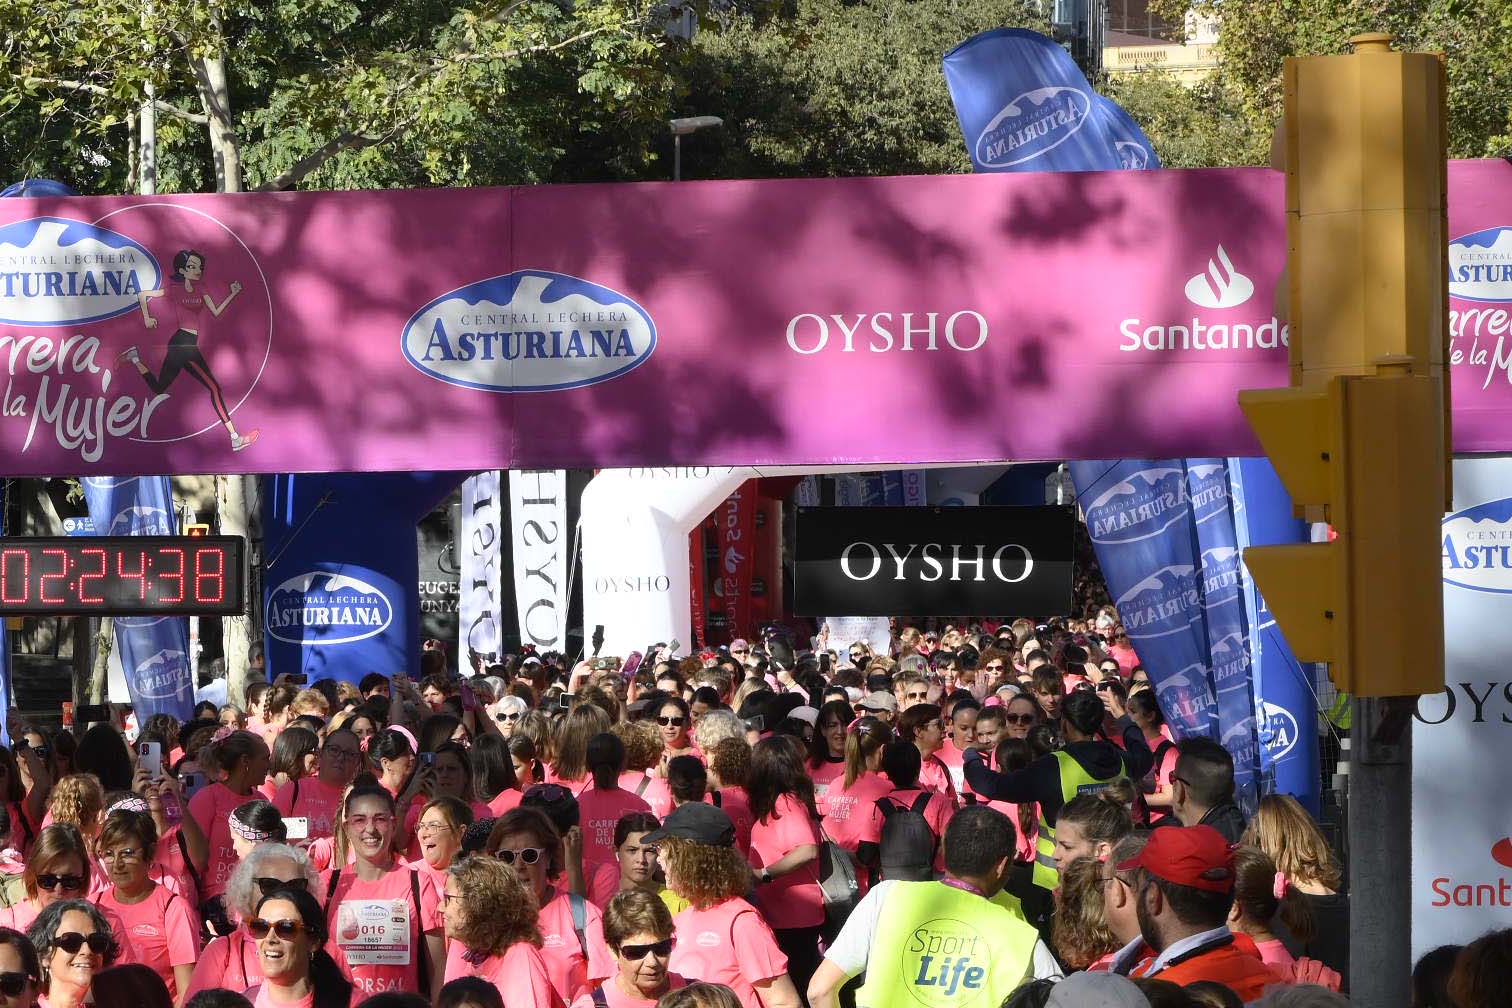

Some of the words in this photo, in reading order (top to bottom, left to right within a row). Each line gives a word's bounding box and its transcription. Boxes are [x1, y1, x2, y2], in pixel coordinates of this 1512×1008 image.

[64, 253, 136, 265] LECHERA
[461, 311, 539, 326] CENTRAL
[547, 310, 629, 323] LECHERA
[786, 309, 989, 354] OYSHO
[421, 316, 637, 362] ASTURIANA
[1469, 338, 1487, 366] la
[2, 375, 27, 418] la
[22, 368, 171, 463] Mujer
[521, 470, 559, 647] OYSH
[840, 541, 1034, 583] OYSHO
[1, 549, 223, 604] 02:24:38
[595, 575, 670, 594] OYSHO
[329, 596, 378, 604] LECHERA
[269, 601, 383, 629] ASTURIANA
[596, 829, 610, 837] DE
[361, 925, 385, 936] 016
[910, 928, 979, 957] Sport
[914, 956, 985, 996] Life
